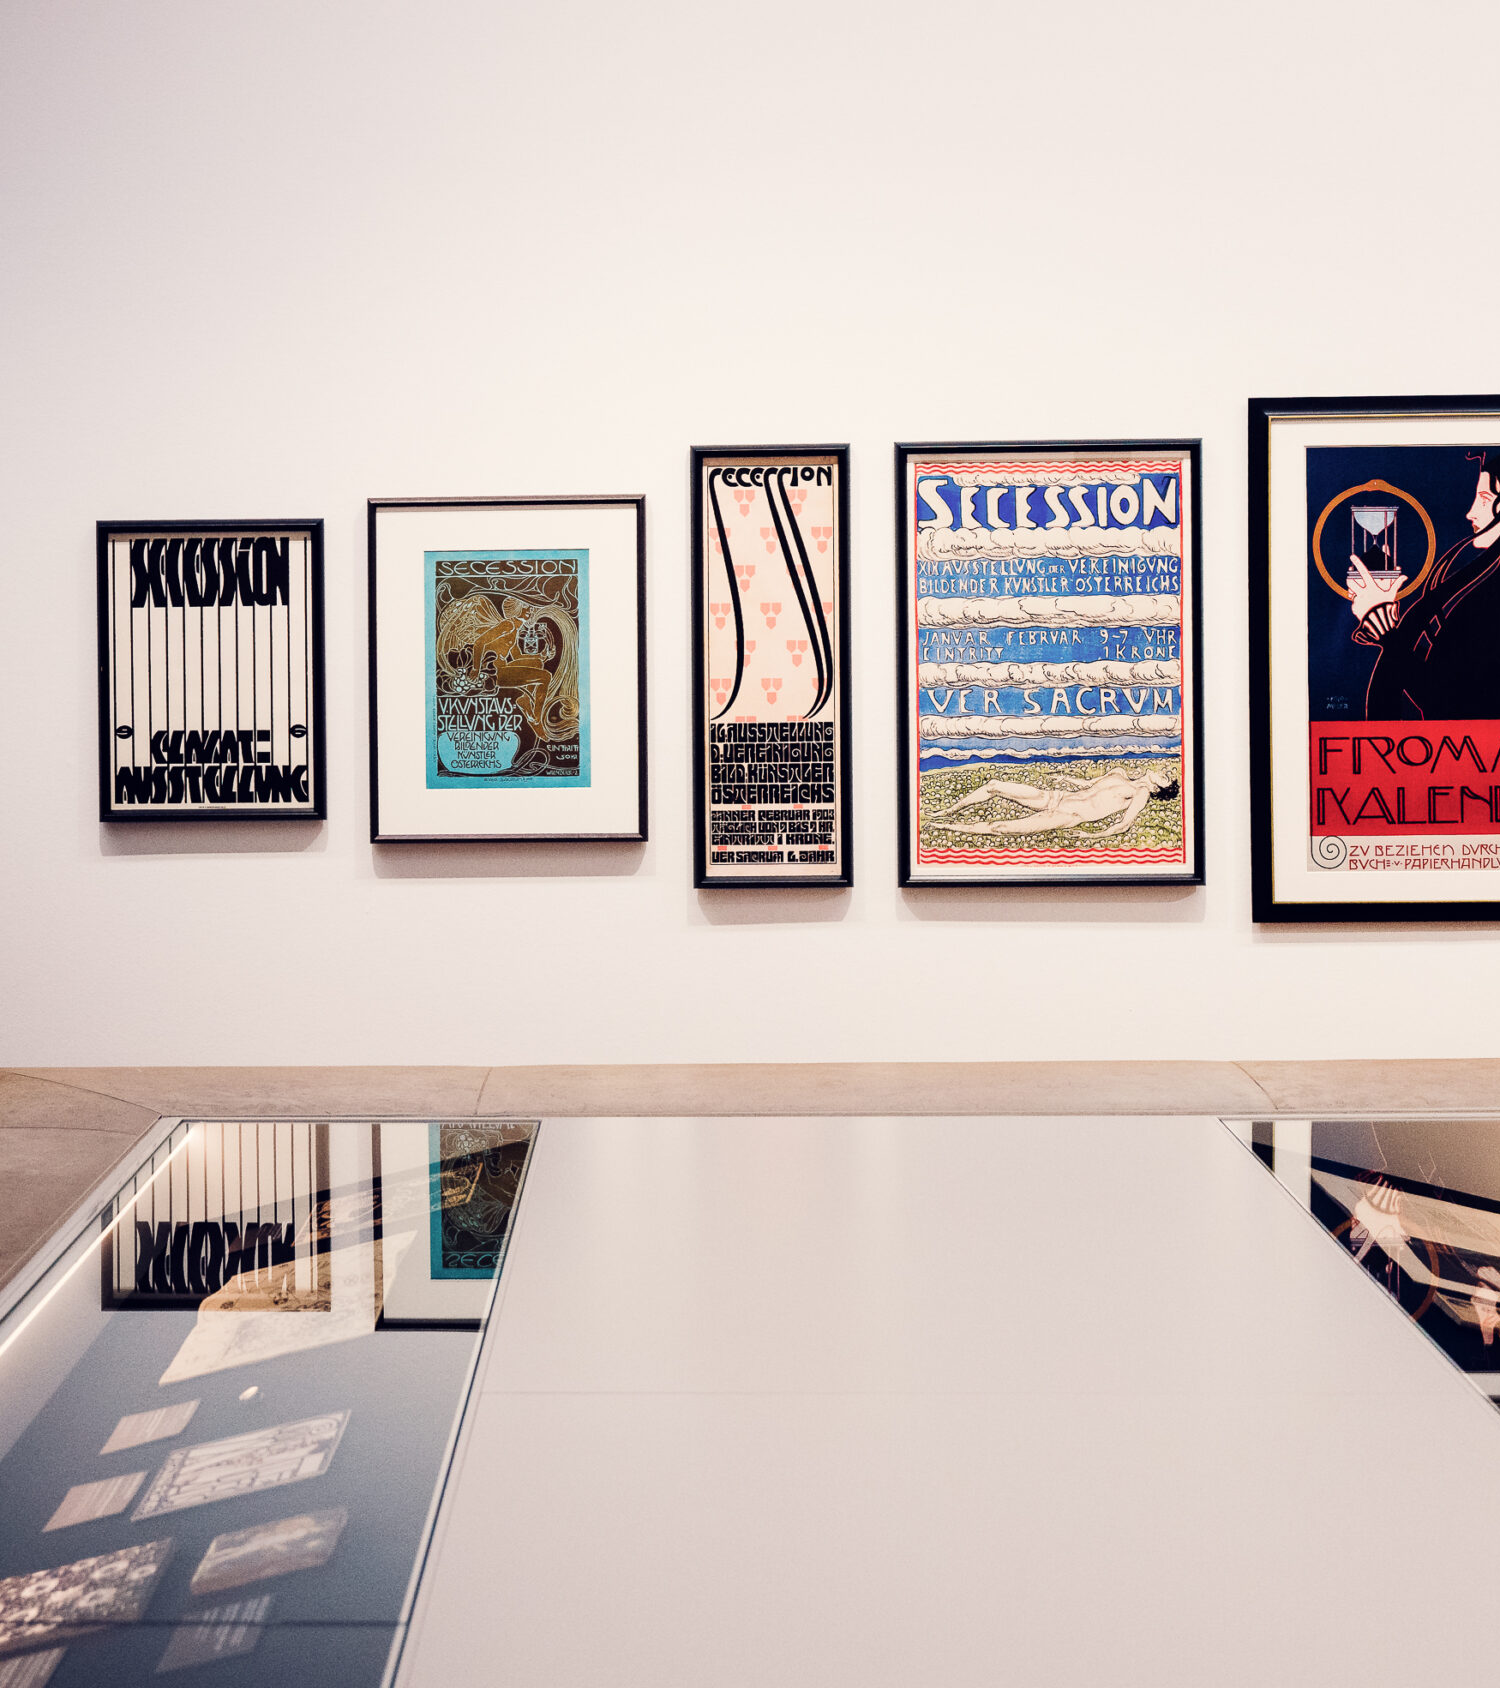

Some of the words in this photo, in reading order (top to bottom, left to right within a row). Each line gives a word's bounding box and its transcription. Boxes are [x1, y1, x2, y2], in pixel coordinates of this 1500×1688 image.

[918, 478, 1177, 528] SECESSION
[131, 537, 290, 608] SECESSION
[438, 560, 576, 575] SECESSION
[918, 577, 1000, 594] BILDENDER
[923, 647, 1004, 661] EINTRITT
[1116, 645, 1177, 660] KRONE
[927, 688, 1002, 714] VER
[498, 714, 523, 731] DER
[454, 742, 499, 751] BILDENDER
[115, 765, 310, 804] AUSSTELLUNG
[711, 784, 835, 804] ÖSTERREICHS
[758, 810, 810, 821] FEBRUAR
[789, 821, 809, 832] BIS
[712, 833, 775, 845] EINTRITT
[736, 850, 784, 862] SACRUM
[1375, 844, 1455, 857] BEZIEHEN
